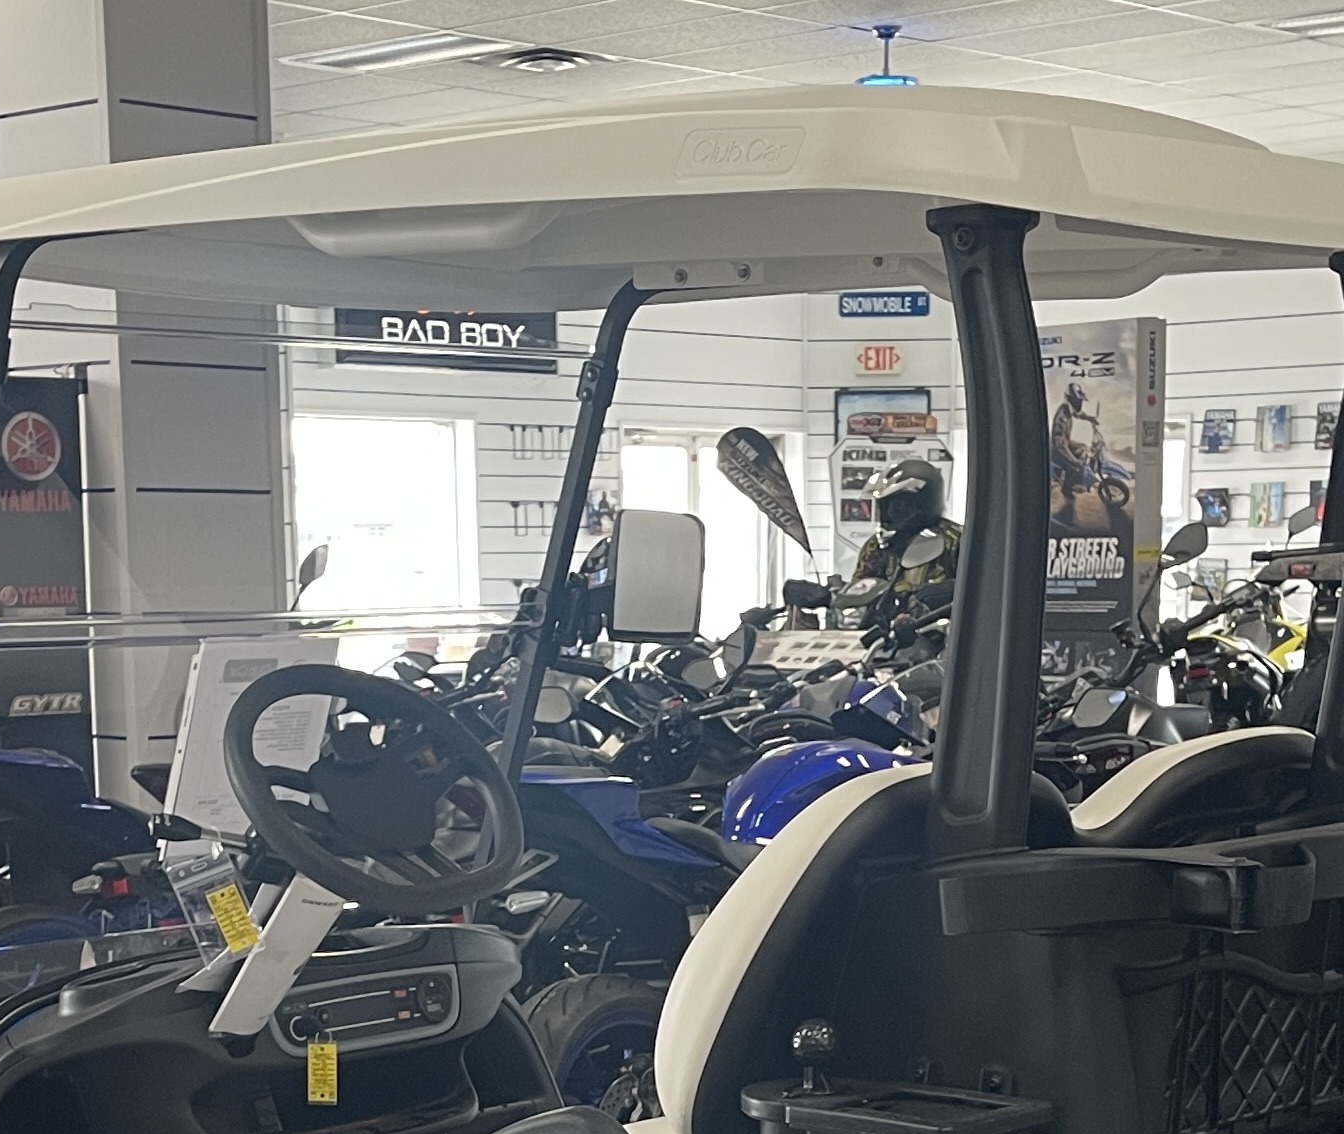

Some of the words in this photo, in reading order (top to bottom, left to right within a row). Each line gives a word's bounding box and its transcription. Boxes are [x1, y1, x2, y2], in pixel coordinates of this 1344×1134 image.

[693, 139, 742, 164] Club
[746, 138, 788, 161] Car
[842, 297, 912, 313] SNOWMOBILE
[381, 316, 451, 345] BAD
[460, 322, 525, 348] BOY
[864, 346, 895, 371] EXIT
[1058, 537, 1119, 560] STREETS
[1047, 556, 1125, 579] LAYGROUND
[19, 586, 79, 605] YAMAHA
[11, 693, 83, 716] GYTR
